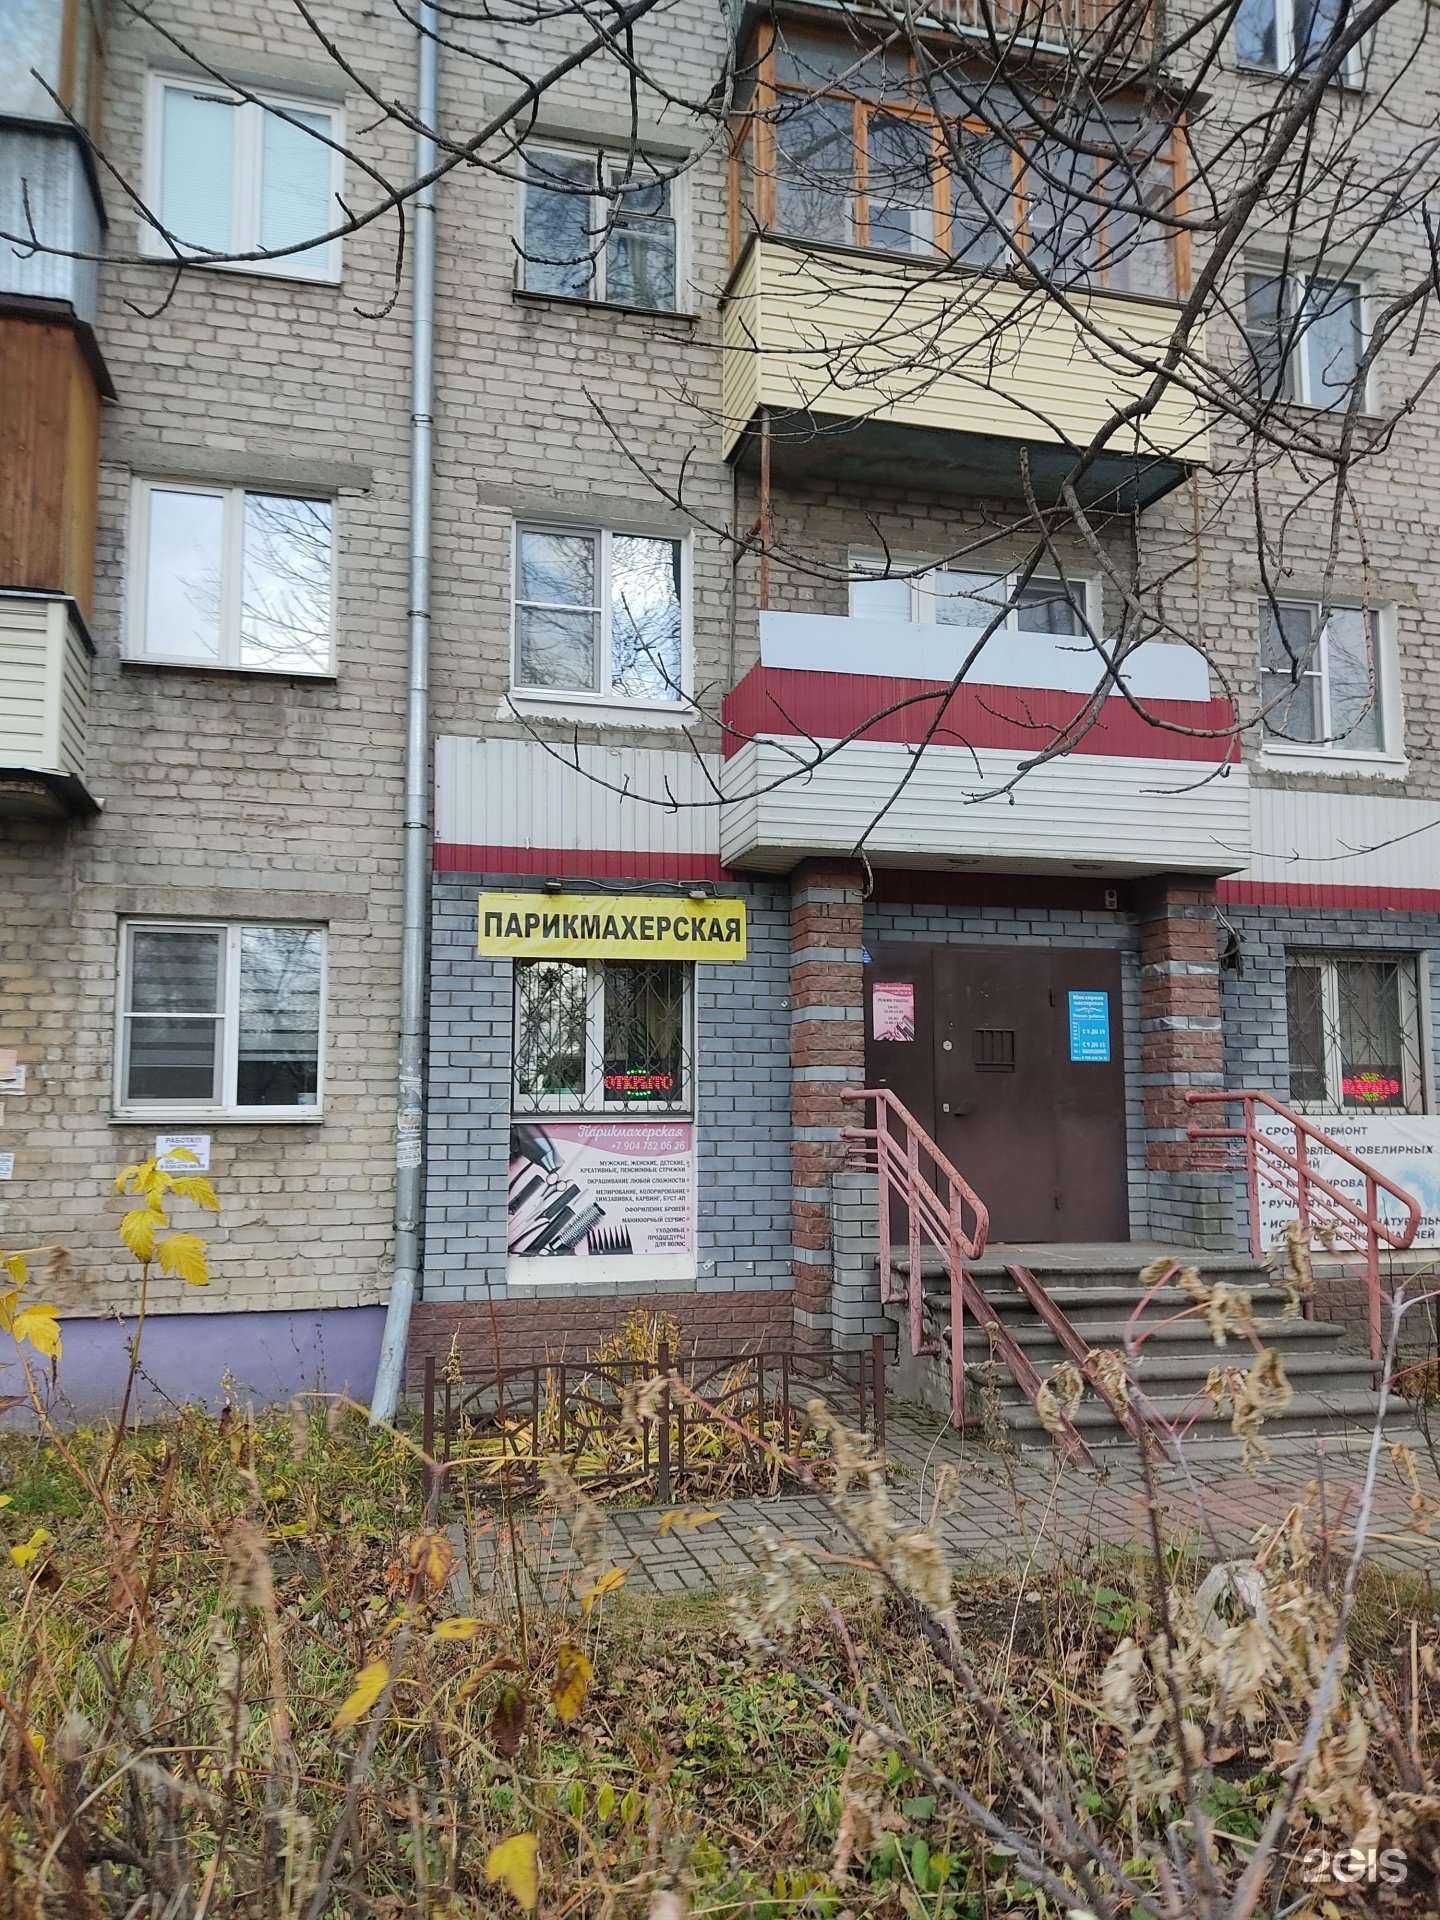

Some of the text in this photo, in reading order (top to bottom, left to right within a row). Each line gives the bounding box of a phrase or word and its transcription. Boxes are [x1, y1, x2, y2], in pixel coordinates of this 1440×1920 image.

[484, 911, 741, 942] ПАРИКМАХЕРСКАЯ
[604, 1075, 673, 1090] ОТКРЫТО
[578, 1124, 684, 1141] Парикмахерская
[1324, 1126, 1368, 1136] РЕМОНТ
[611, 1141, 621, 1150] +7
[623, 1141, 640, 1151] 904
[1355, 1145, 1433, 1155] ЮВЕЛИРНЫХ
